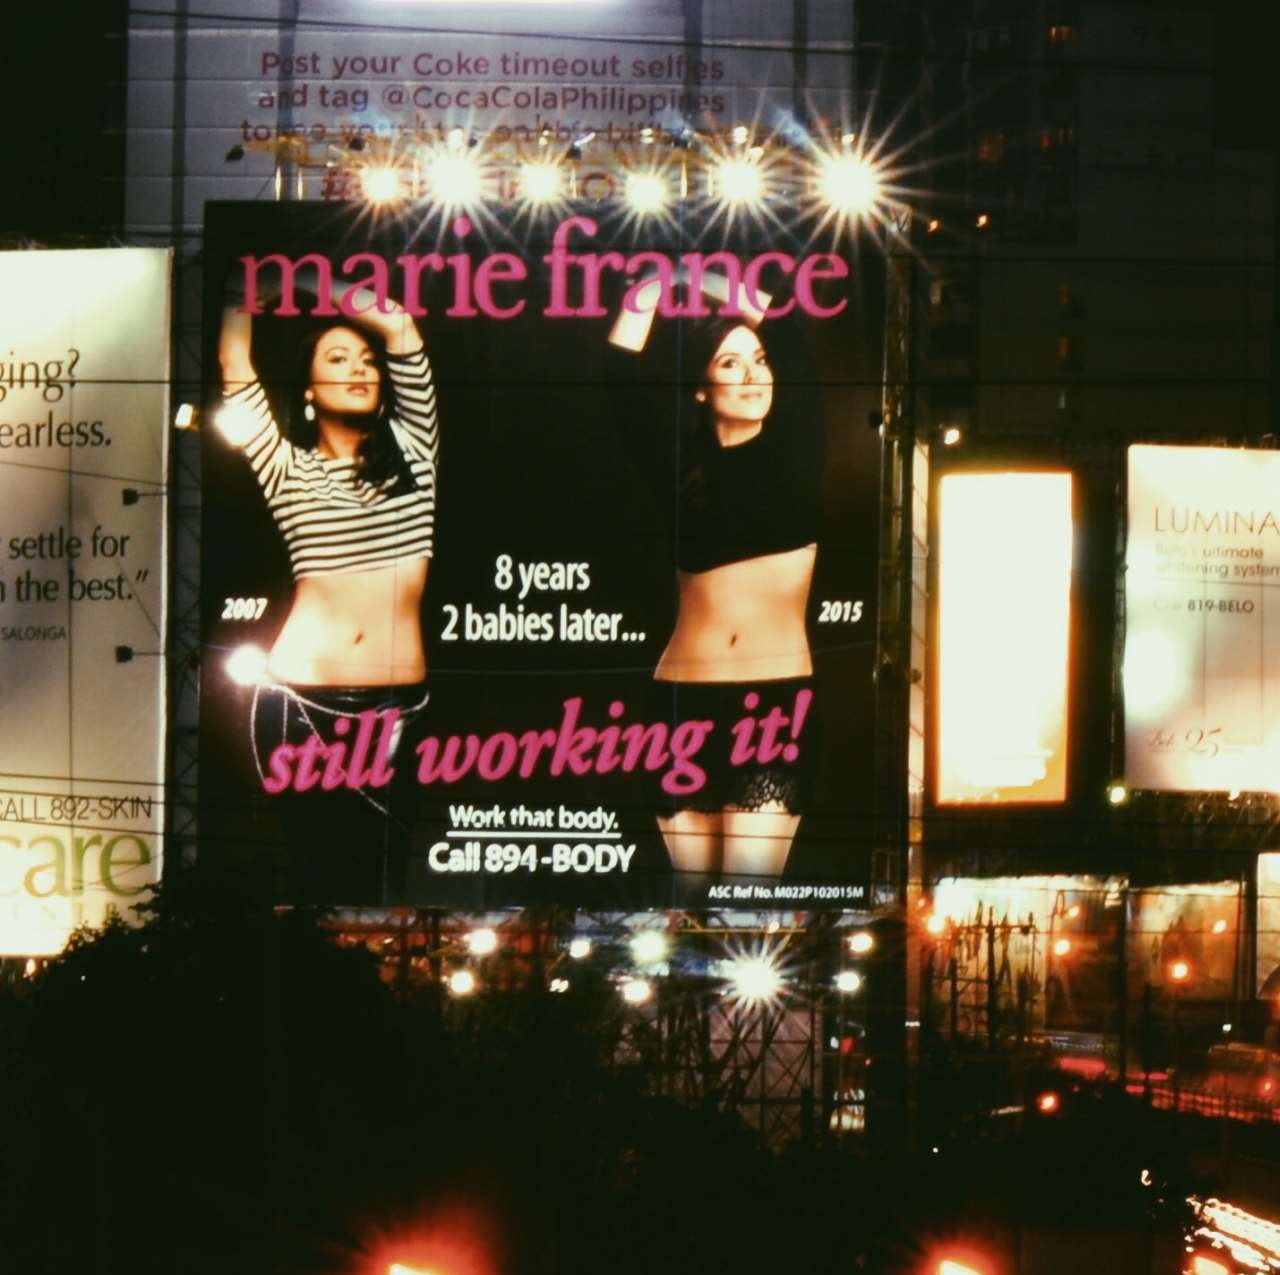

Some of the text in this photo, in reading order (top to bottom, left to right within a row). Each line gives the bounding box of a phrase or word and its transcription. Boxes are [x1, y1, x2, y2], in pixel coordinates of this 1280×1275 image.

[261, 52, 321, 76] Post
[332, 55, 402, 79] your
[413, 52, 490, 76] Coke
[501, 52, 620, 77] timeout
[258, 83, 308, 109] and
[319, 85, 369, 112] tag
[238, 216, 851, 320] marie france
[1154, 507, 1280, 536] LUMINA
[9, 525, 131, 560] settle for
[1203, 547, 1264, 559] ultimate
[15, 569, 60, 602] the
[494, 553, 591, 600] 8 years
[221, 598, 269, 620] 2007
[818, 600, 863, 622] 2015
[1187, 599, 1256, 613] 819-BELO
[1, 624, 67, 641] SALONGA
[440, 602, 646, 642] 2 babies later...
[263, 688, 813, 795] still working it!
[0, 795, 153, 822] ALL 892-SKIN
[449, 804, 620, 834] Work that body.
[428, 842, 480, 872] Call
[708, 886, 732, 899] ASC
[733, 886, 753, 899] Ref
